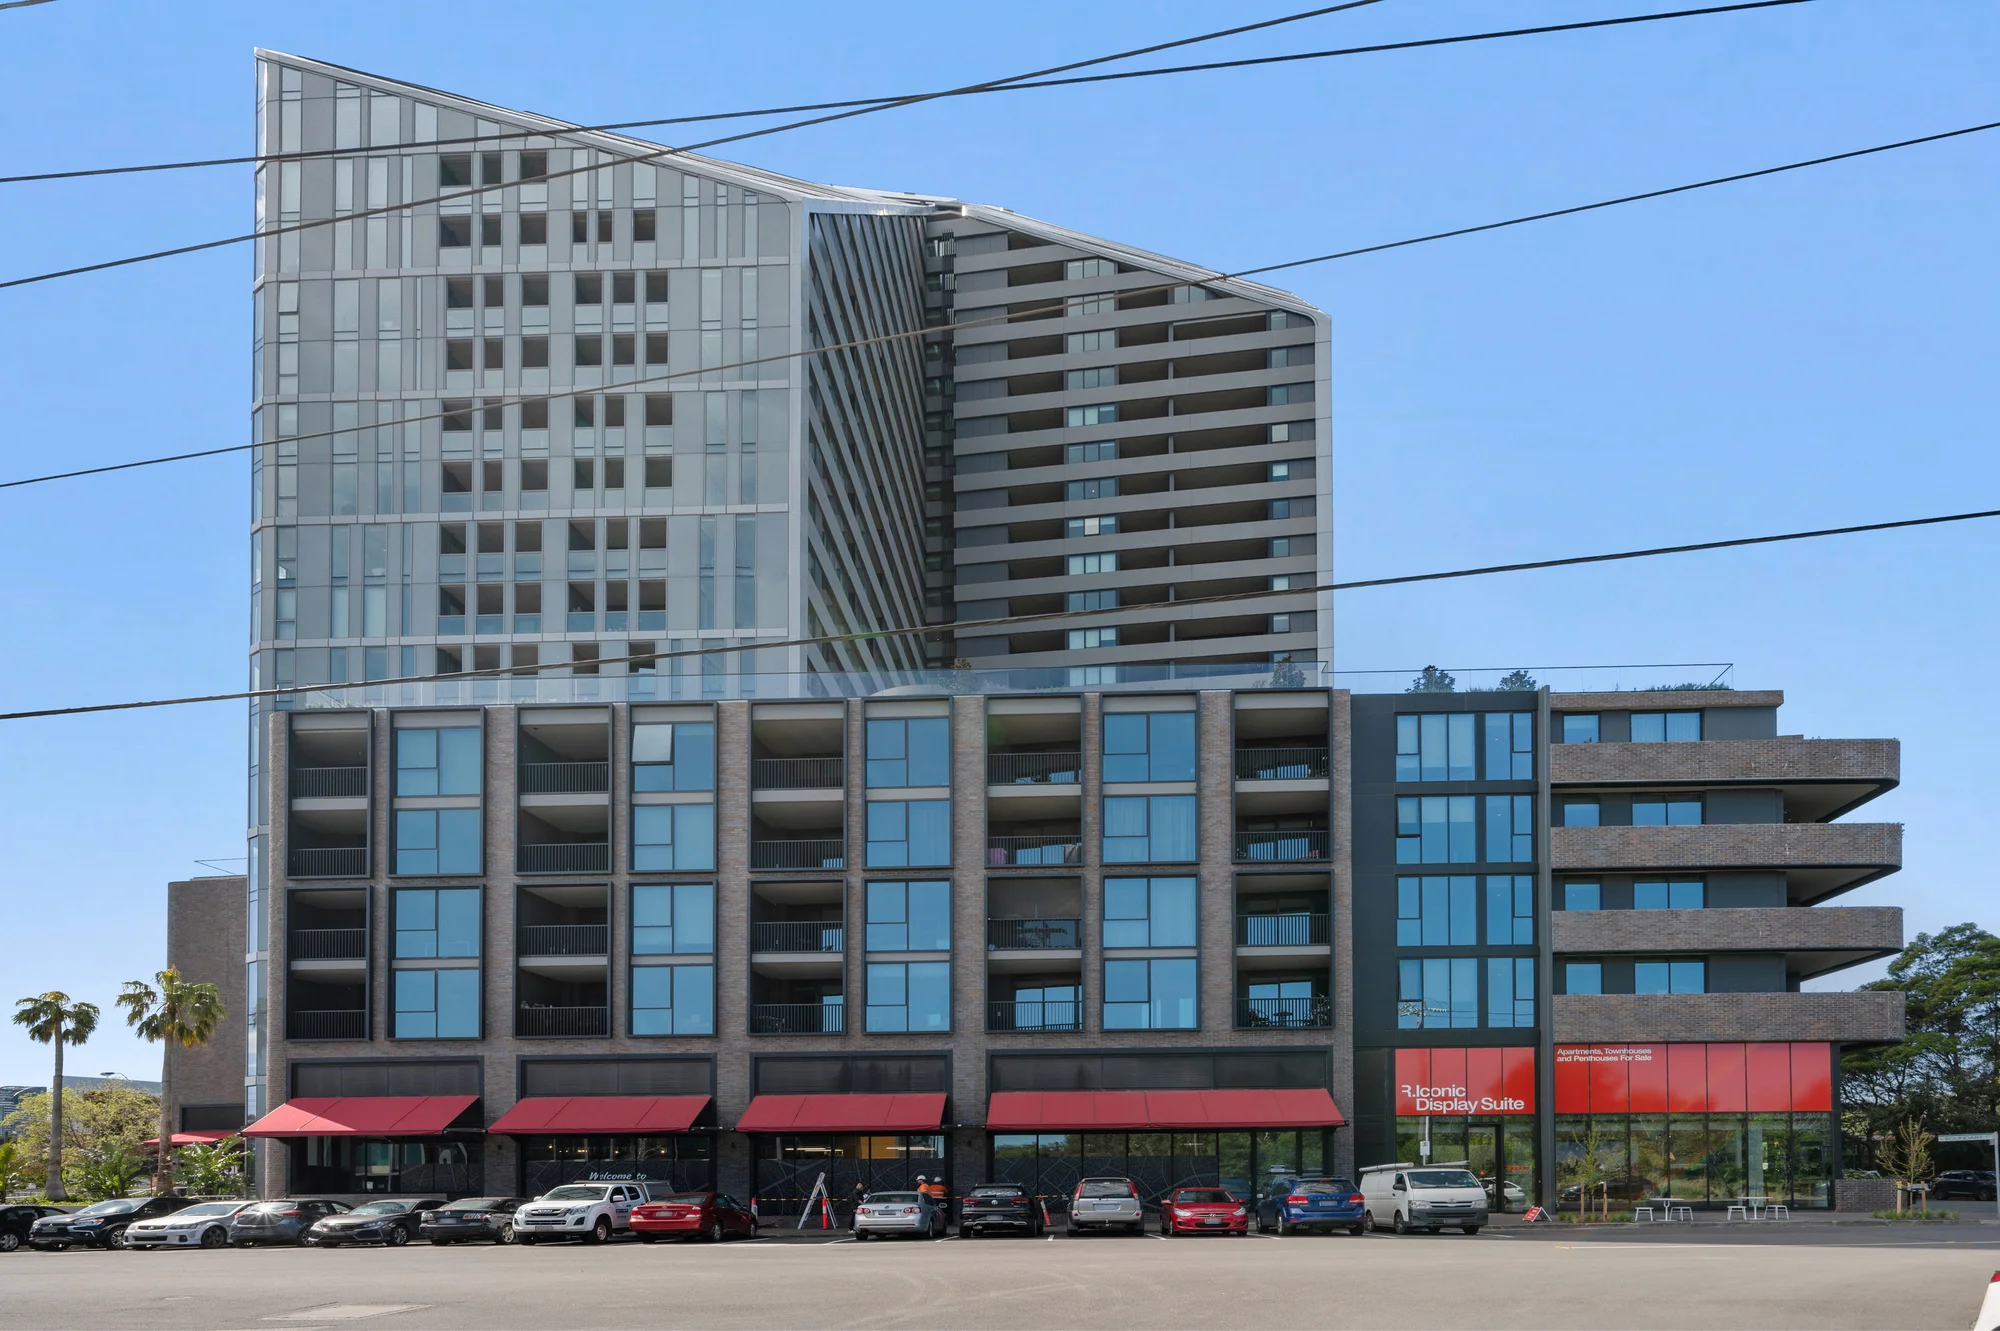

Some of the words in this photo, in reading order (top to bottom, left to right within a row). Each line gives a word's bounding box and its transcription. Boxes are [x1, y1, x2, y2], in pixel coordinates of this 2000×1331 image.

[1416, 1097, 1479, 1114] Display
[1481, 1097, 1525, 1111] Suite
[589, 1171, 632, 1180] Welcome
[636, 1172, 647, 1180] to
